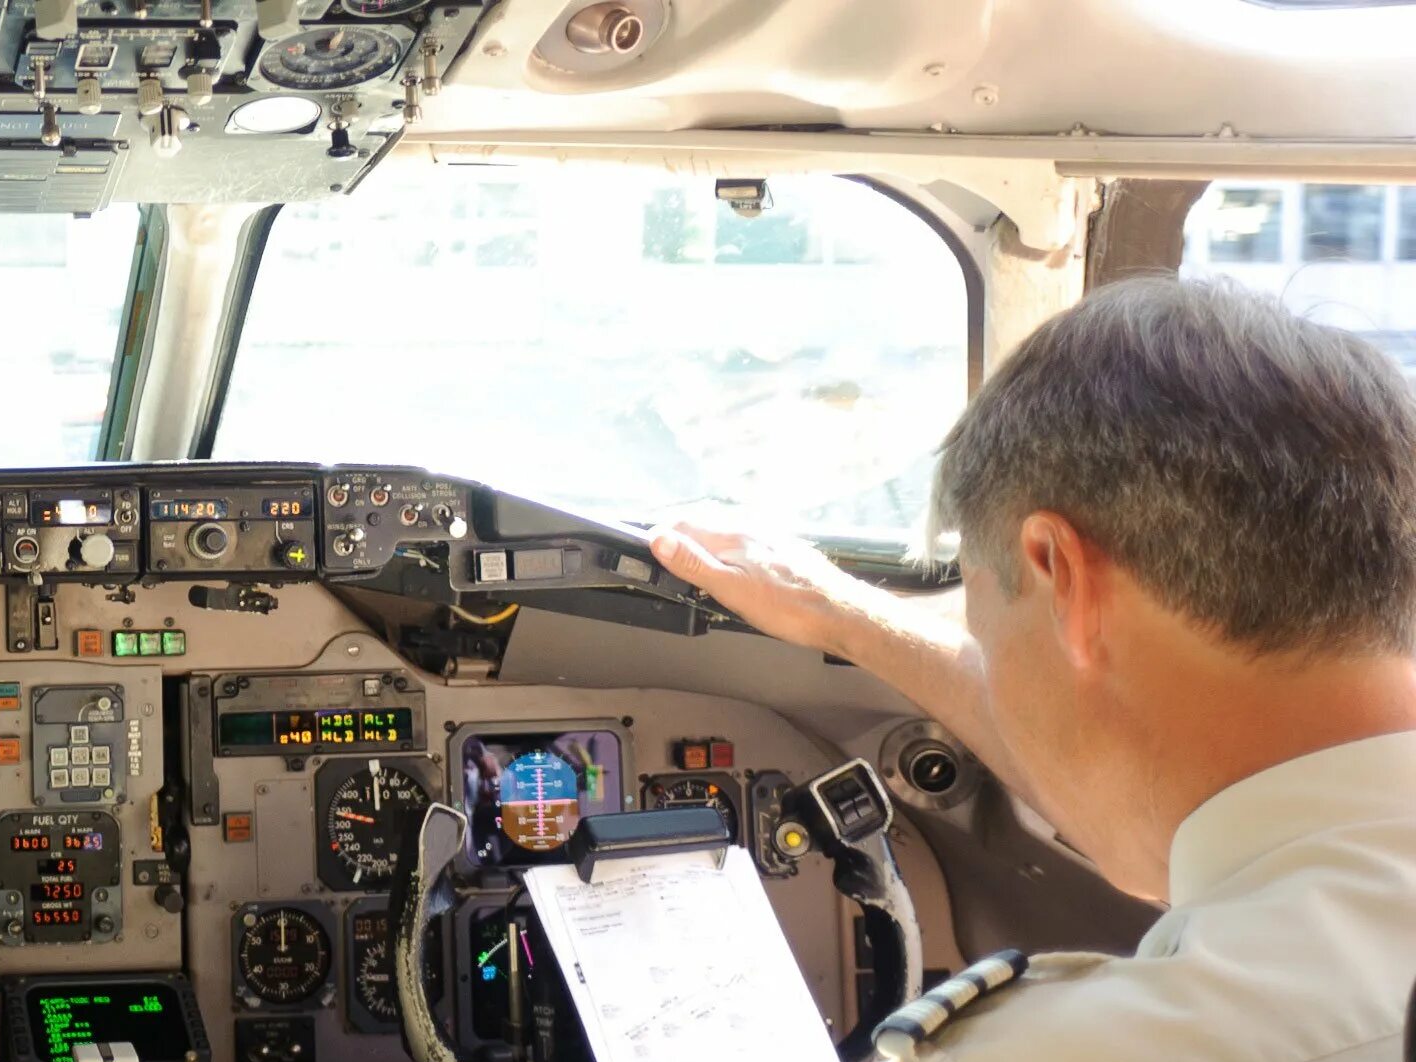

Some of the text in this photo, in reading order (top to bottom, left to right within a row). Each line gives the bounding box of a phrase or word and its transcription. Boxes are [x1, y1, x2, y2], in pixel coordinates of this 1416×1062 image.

[270, 502, 301, 515] 220
[321, 714, 353, 726] HDG
[364, 713, 395, 726] ALT
[321, 730, 354, 743] HLD
[397, 790, 411, 799] 100
[33, 813, 79, 827] FUEL QTY
[335, 820, 351, 829] 300
[338, 833, 354, 842] 250
[344, 843, 361, 851] 240
[58, 860, 74, 872] 25
[372, 859, 388, 868] 200
[34, 911, 79, 924] 56550
